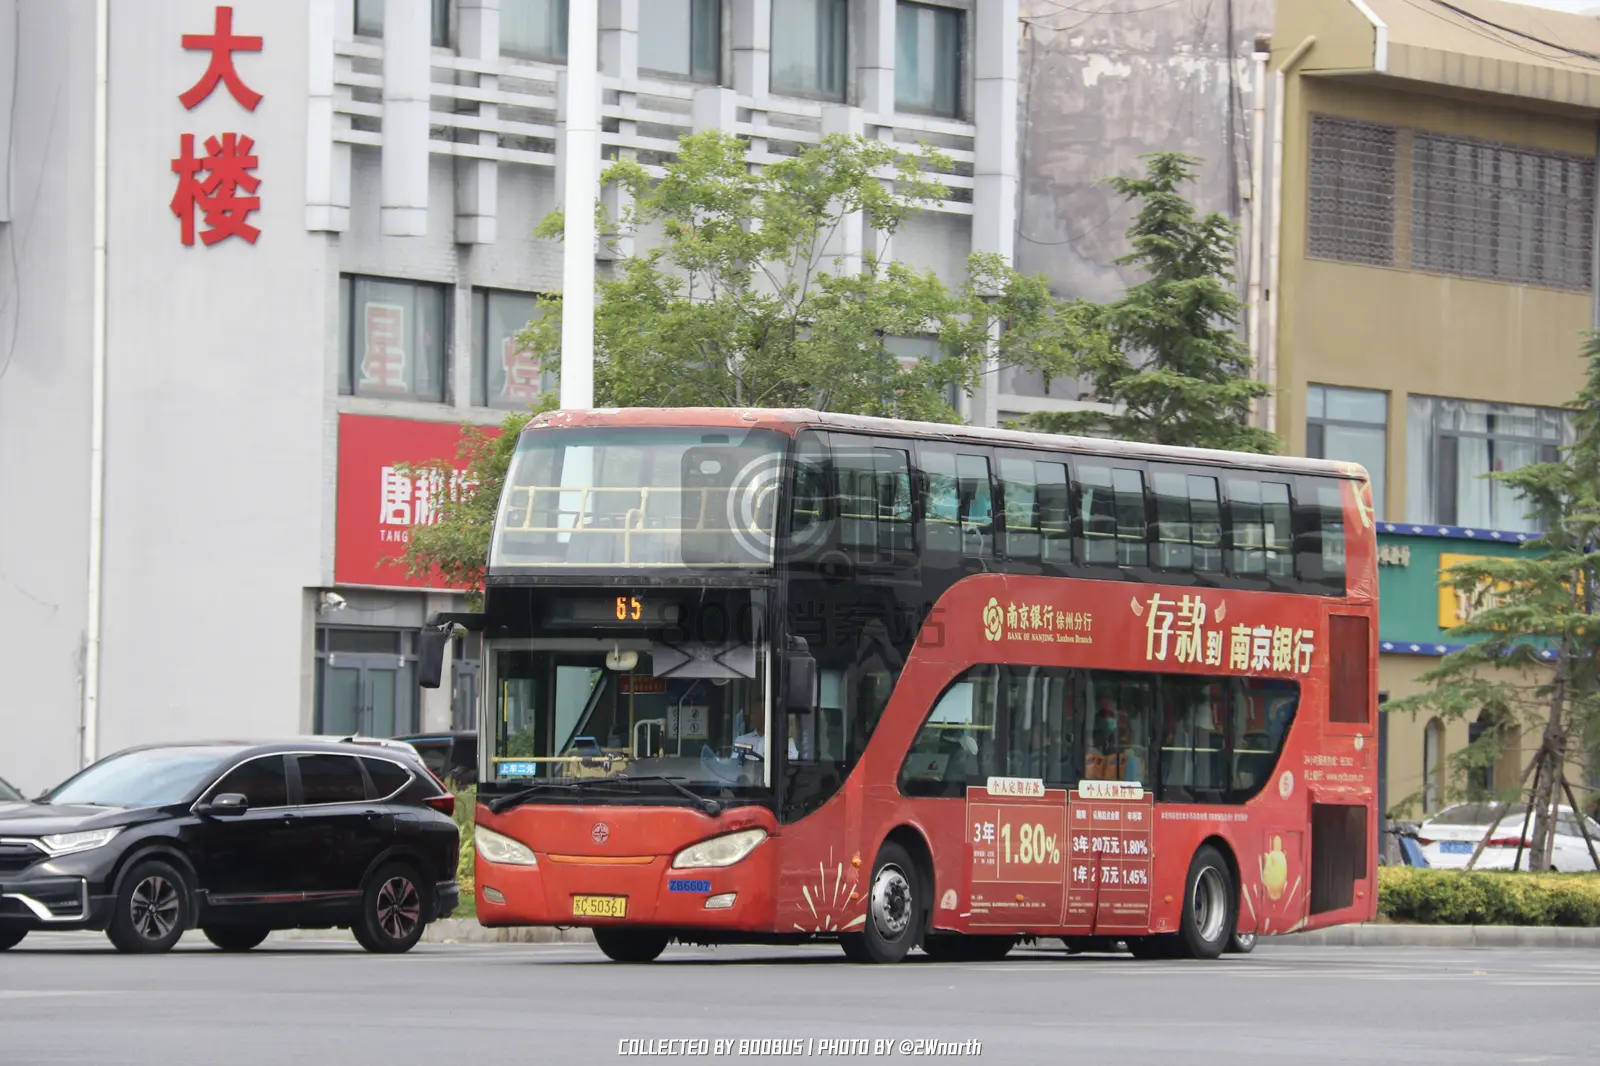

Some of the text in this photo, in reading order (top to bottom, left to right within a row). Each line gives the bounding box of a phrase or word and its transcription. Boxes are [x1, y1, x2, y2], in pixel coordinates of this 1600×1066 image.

[170, 6, 263, 246] 大楼
[380, 530, 408, 542] TANG
[616, 596, 641, 621] 65
[1007, 601, 1092, 631] 南京银行 徐州分行
[1007, 632, 1022, 641] BANK
[1023, 633, 1030, 641] OF
[1032, 634, 1054, 643] NANJING
[501, 764, 534, 774] 上车二元
[993, 780, 1040, 794] 个人定期存款
[974, 822, 995, 845] 3年
[1001, 823, 1060, 864] 1.80%
[1073, 835, 1147, 855] 3年 20万元 1.80%
[1073, 865, 1088, 884] 1年
[1123, 869, 1147, 885] 1.45%
[670, 880, 710, 892] ZB6607
